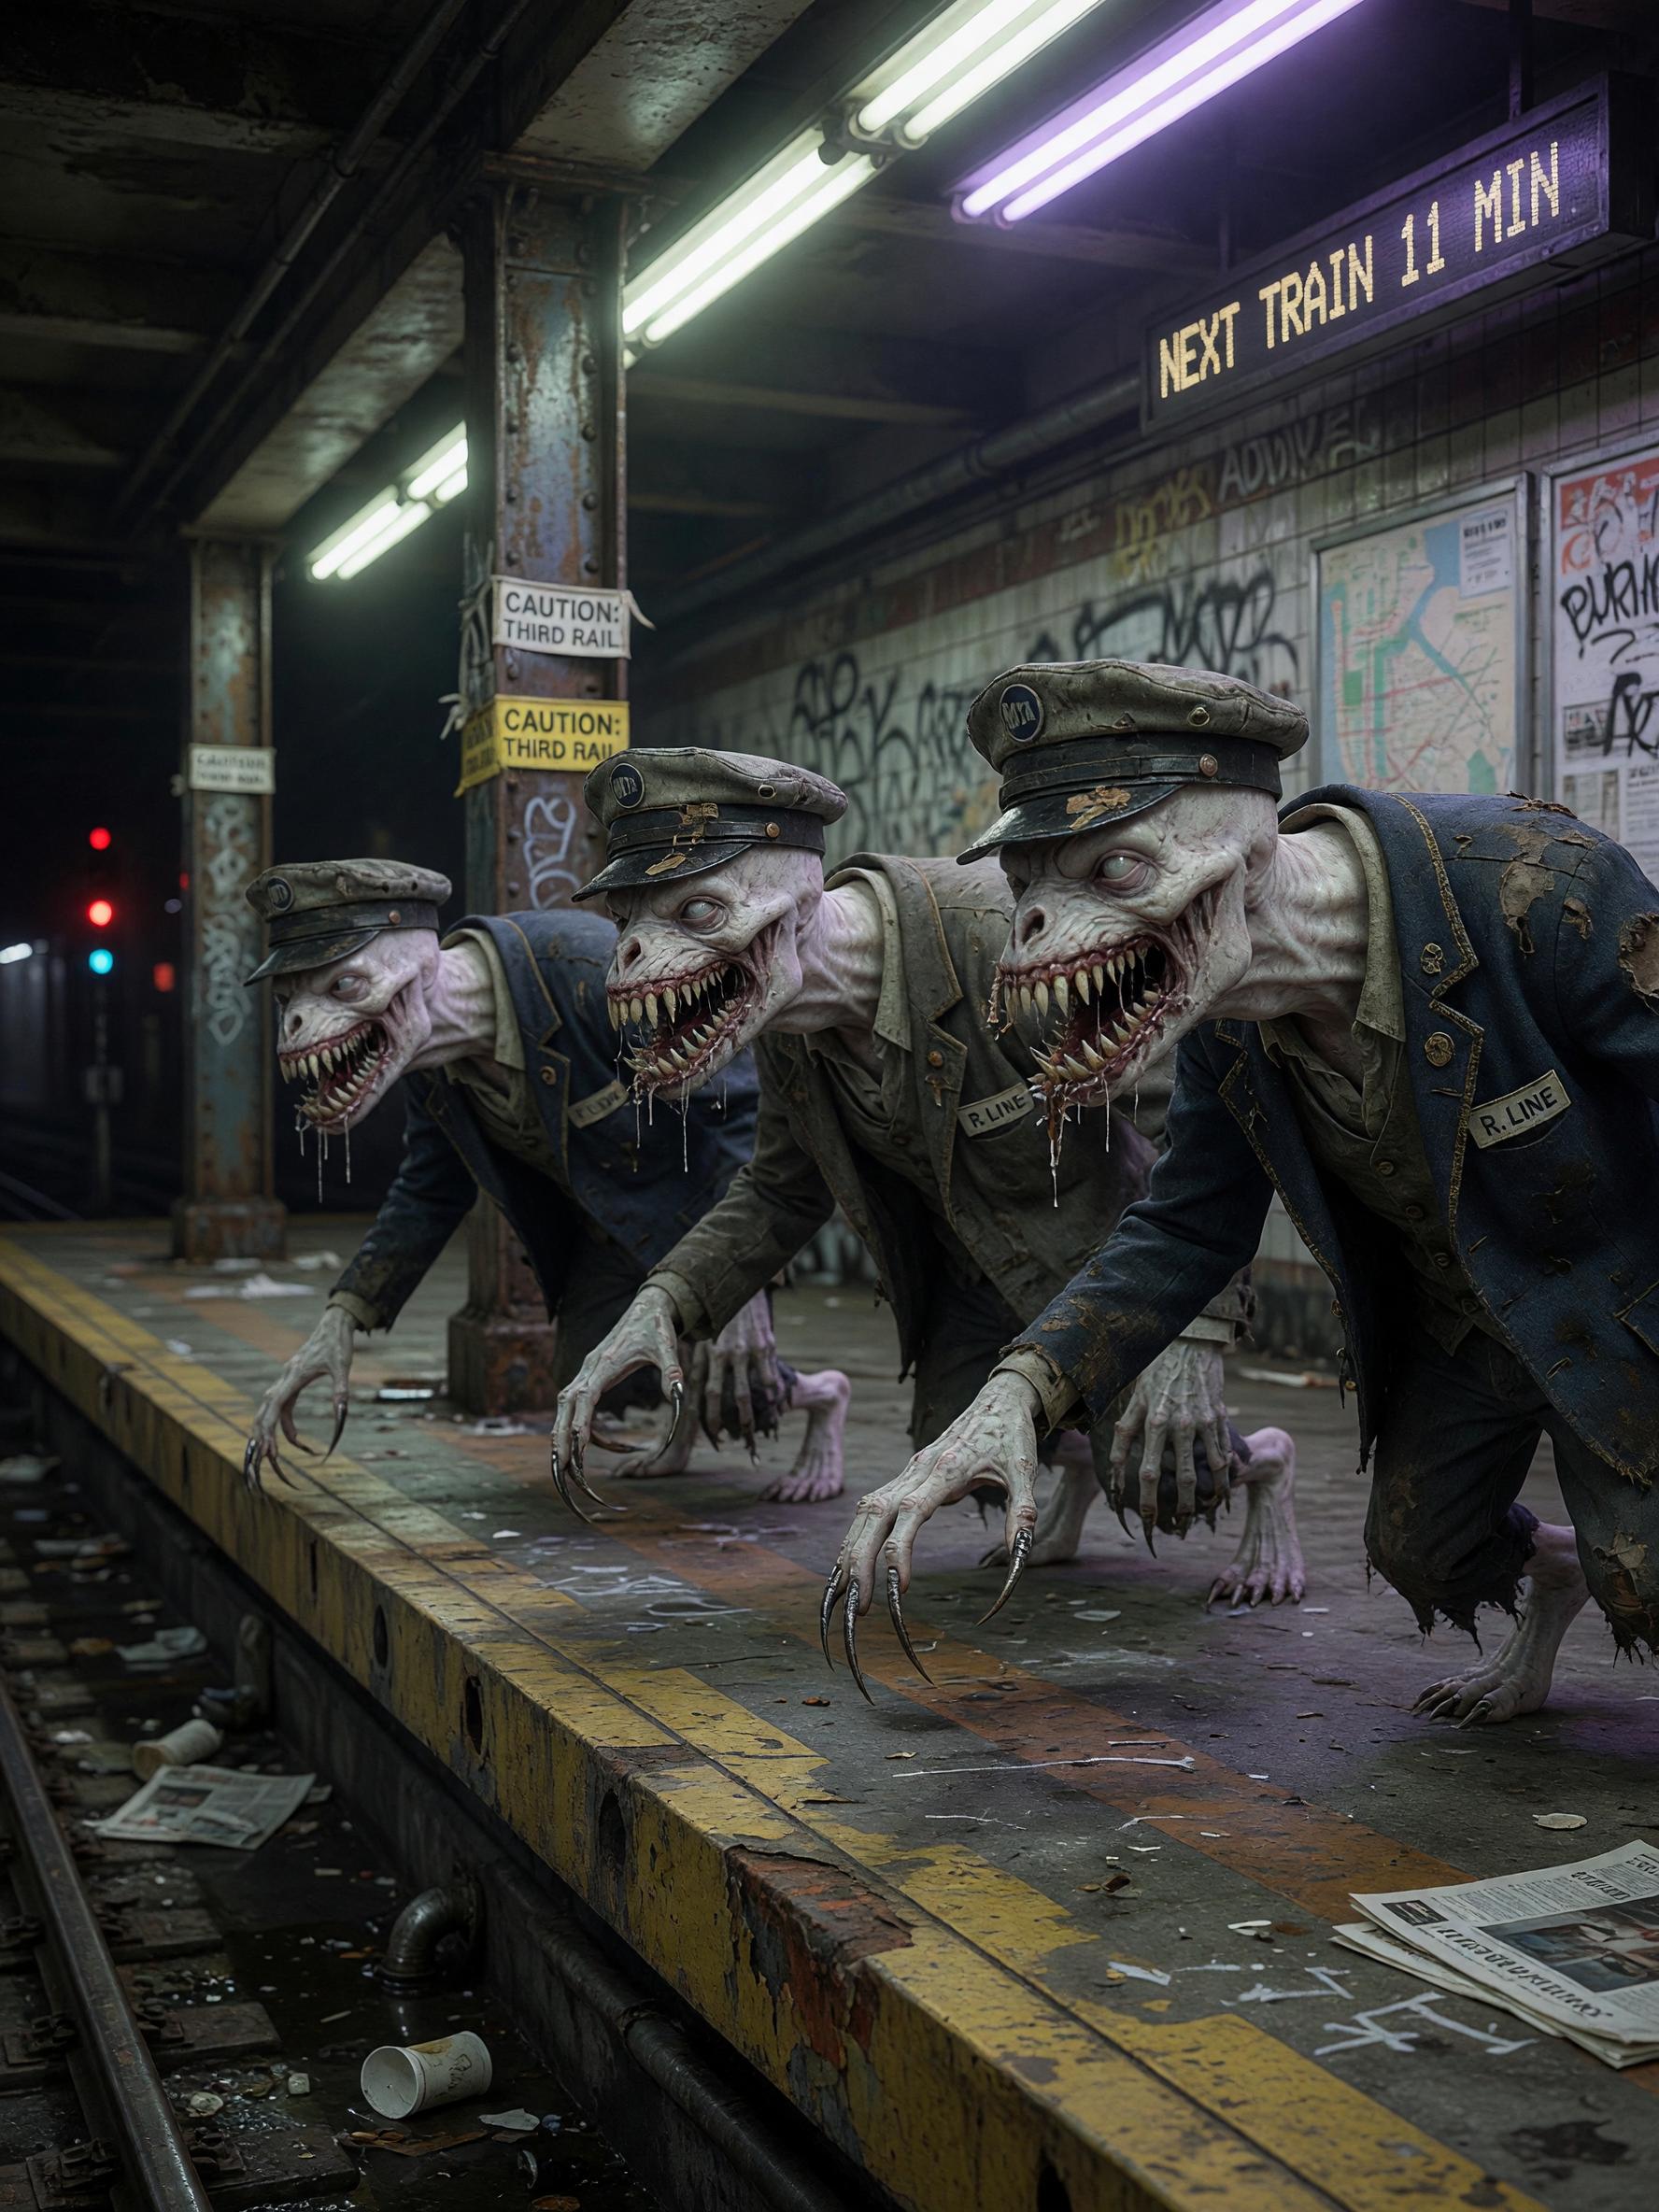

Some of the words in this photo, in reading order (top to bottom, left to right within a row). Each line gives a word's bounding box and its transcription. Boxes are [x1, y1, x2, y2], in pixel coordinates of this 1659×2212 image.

[1159, 302, 1241, 398] NEXT
[1259, 235, 1374, 349] TRAIN
[1401, 201, 1445, 287] 11
[1474, 141, 1560, 252] MIN
[505, 591, 619, 624] CAUTION:
[503, 619, 565, 645] THIRD
[573, 629, 620, 649] RAIL
[504, 709, 620, 736] CAUTION:
[503, 737, 566, 759] THIRD
